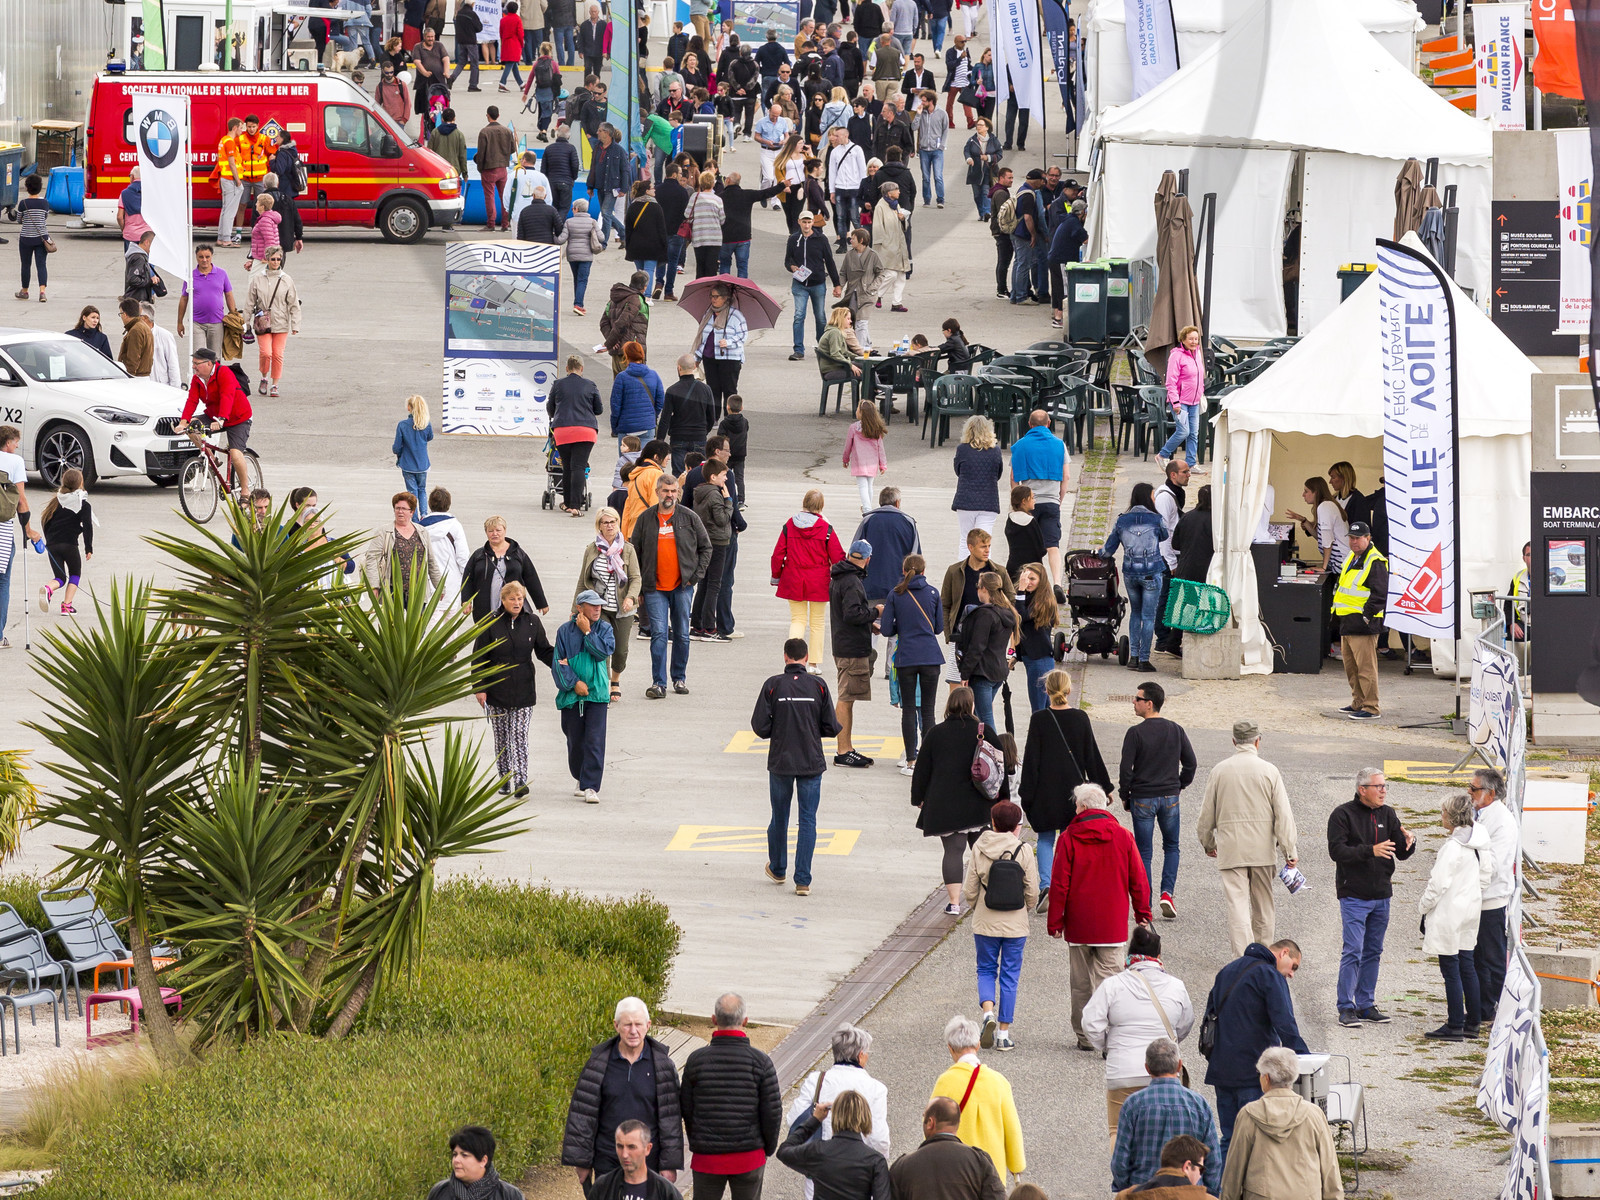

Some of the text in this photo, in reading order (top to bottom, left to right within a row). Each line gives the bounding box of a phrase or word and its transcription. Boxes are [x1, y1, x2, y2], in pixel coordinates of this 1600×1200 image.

[475, 4, 499, 15] FRANÇAIS
[1010, 3, 1018, 15] QUI
[1011, 18, 1021, 35] MER
[1146, 3, 1157, 65] GRAND OUEST
[1500, 16, 1511, 58] FRANCE
[1016, 35, 1022, 48] LA
[1137, 32, 1149, 66] BANQUE
[1018, 49, 1028, 69] C'EST
[122, 85, 310, 96] SOCIETE NATIONALE DE SAUVETAGE EN MER
[119, 152, 139, 162] CENT
[483, 250, 523, 264] PLAN
[4, 407, 23, 424] X2
[1543, 506, 1600, 519] EMBARC
[1543, 521, 1561, 529] BOAT
[1562, 521, 1597, 529] TERMINAL
